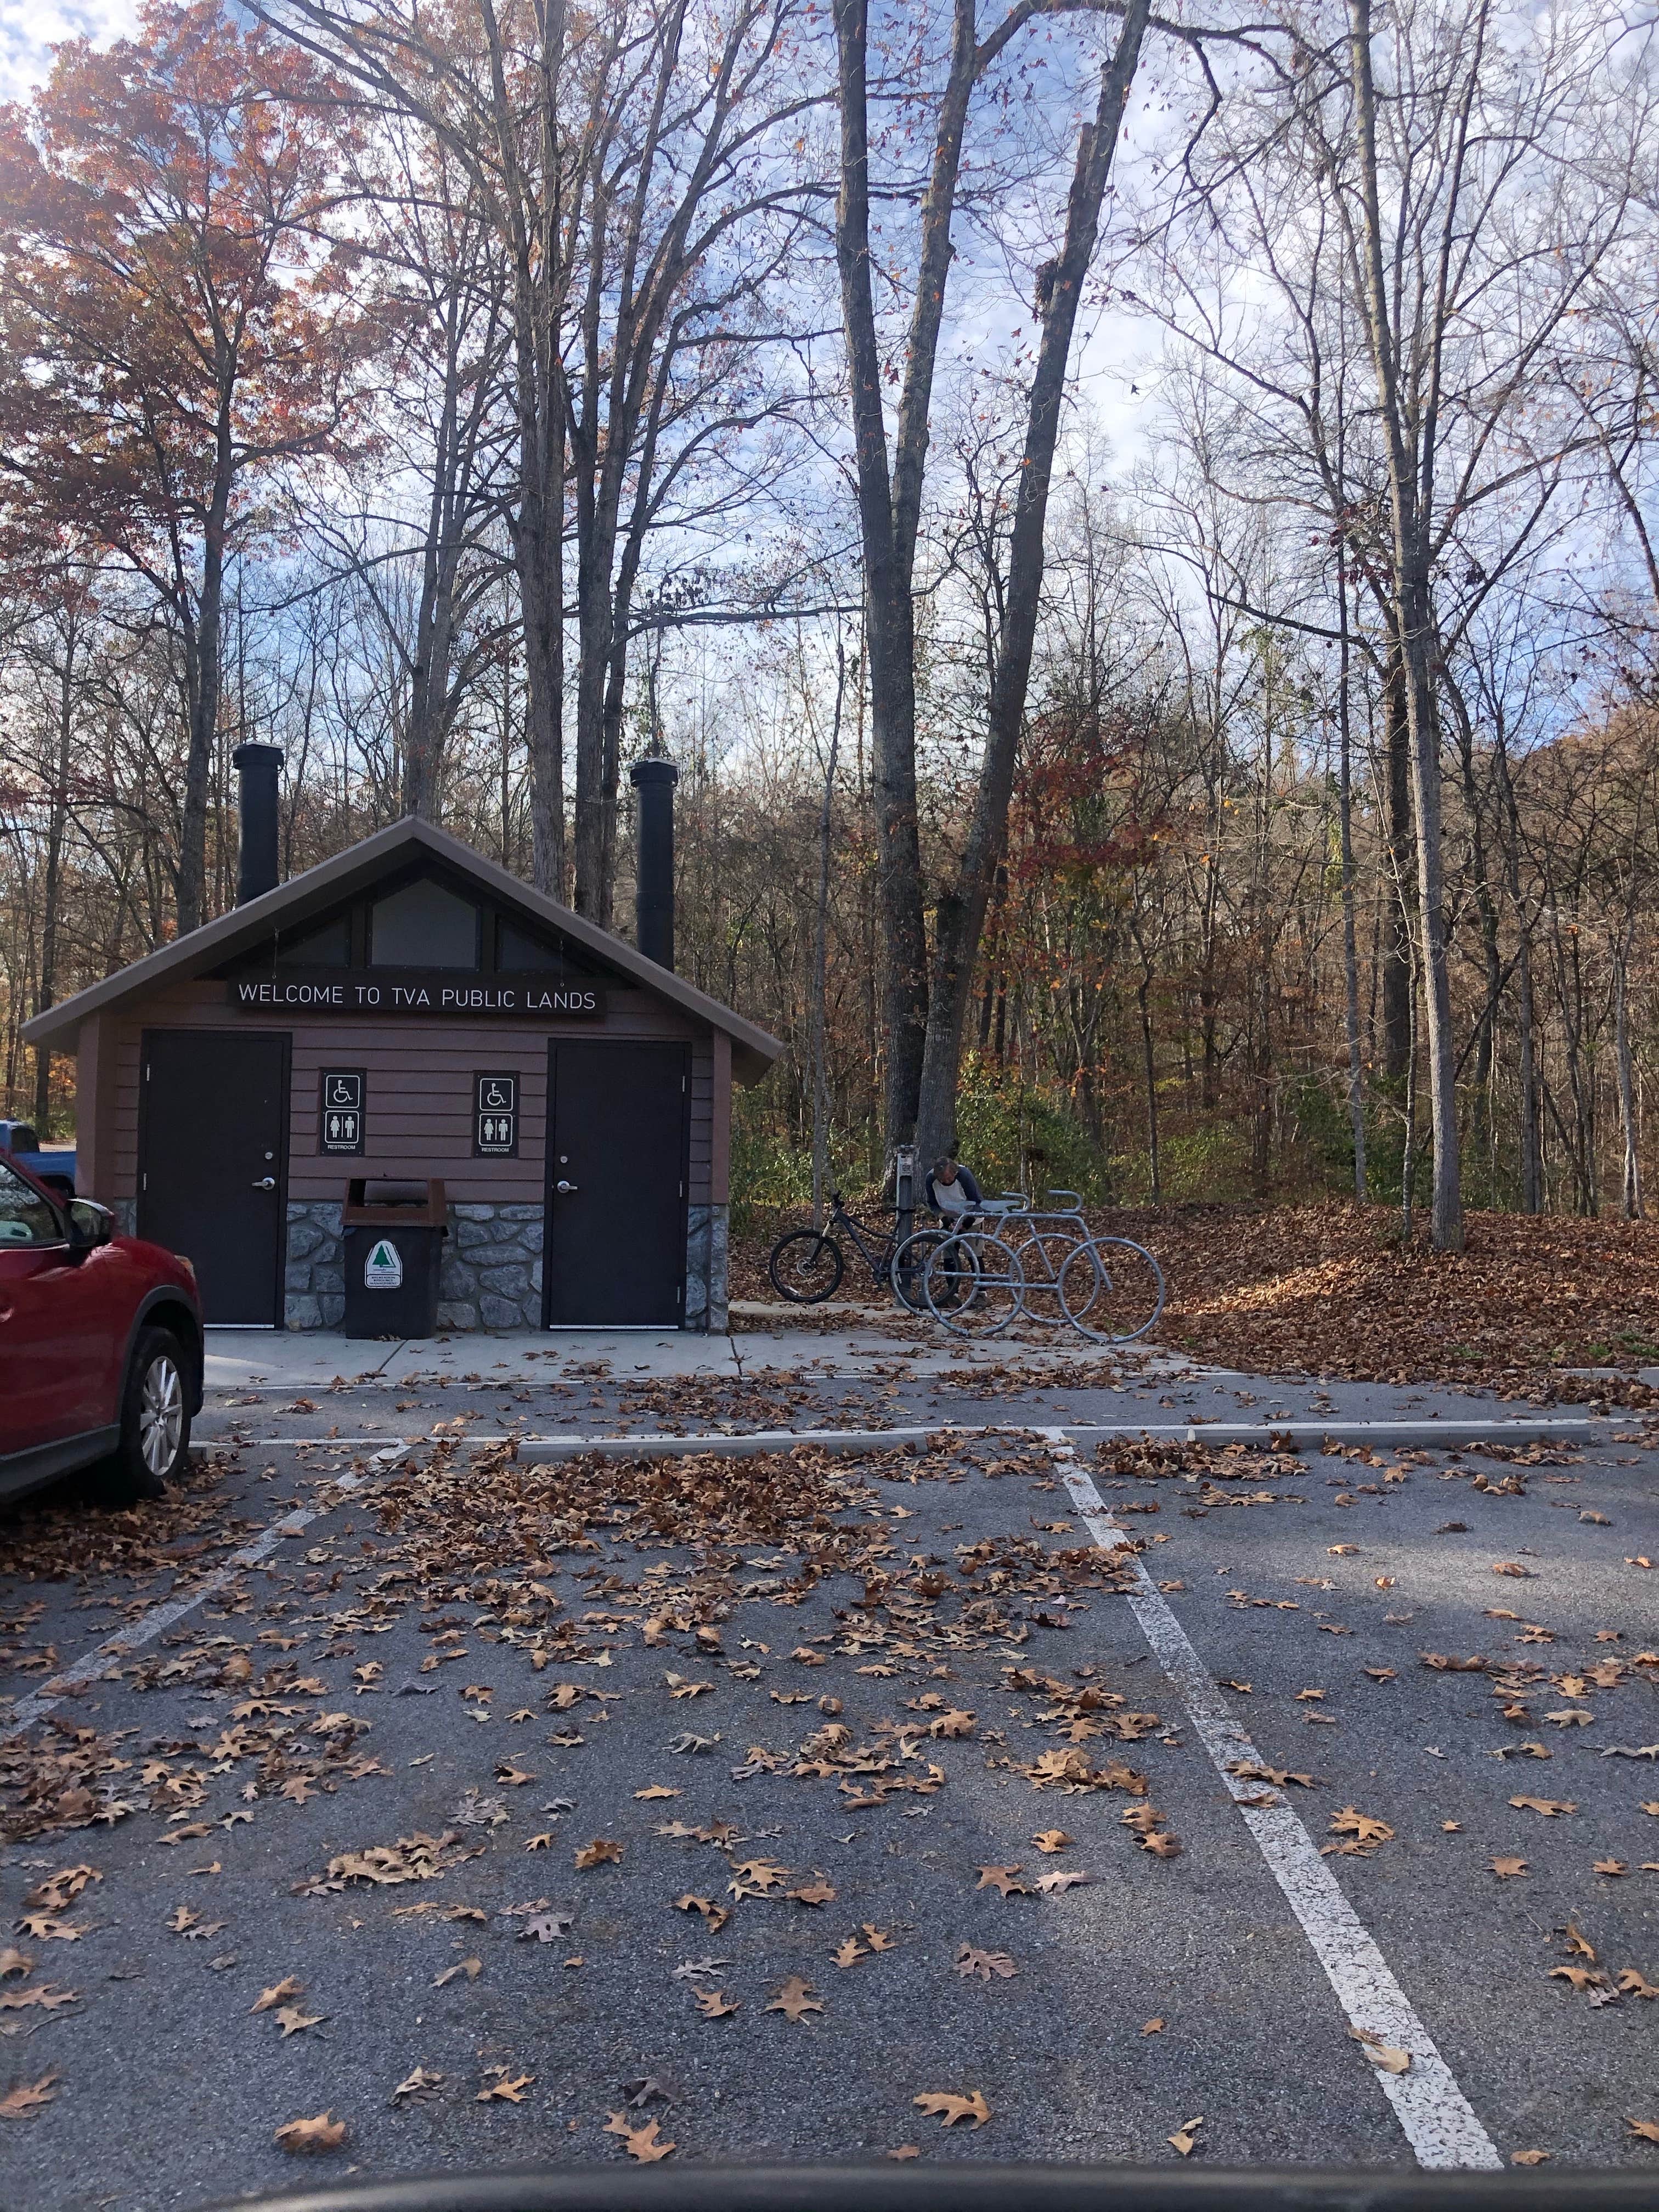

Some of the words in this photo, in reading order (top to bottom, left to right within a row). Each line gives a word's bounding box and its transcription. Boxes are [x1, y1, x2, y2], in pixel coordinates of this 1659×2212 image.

[239, 985, 343, 1003] WELCOME
[355, 987, 379, 1004] TO
[392, 988, 430, 1005] TVA
[442, 990, 515, 1007] PUBLIC
[527, 991, 595, 1009] LANDS
